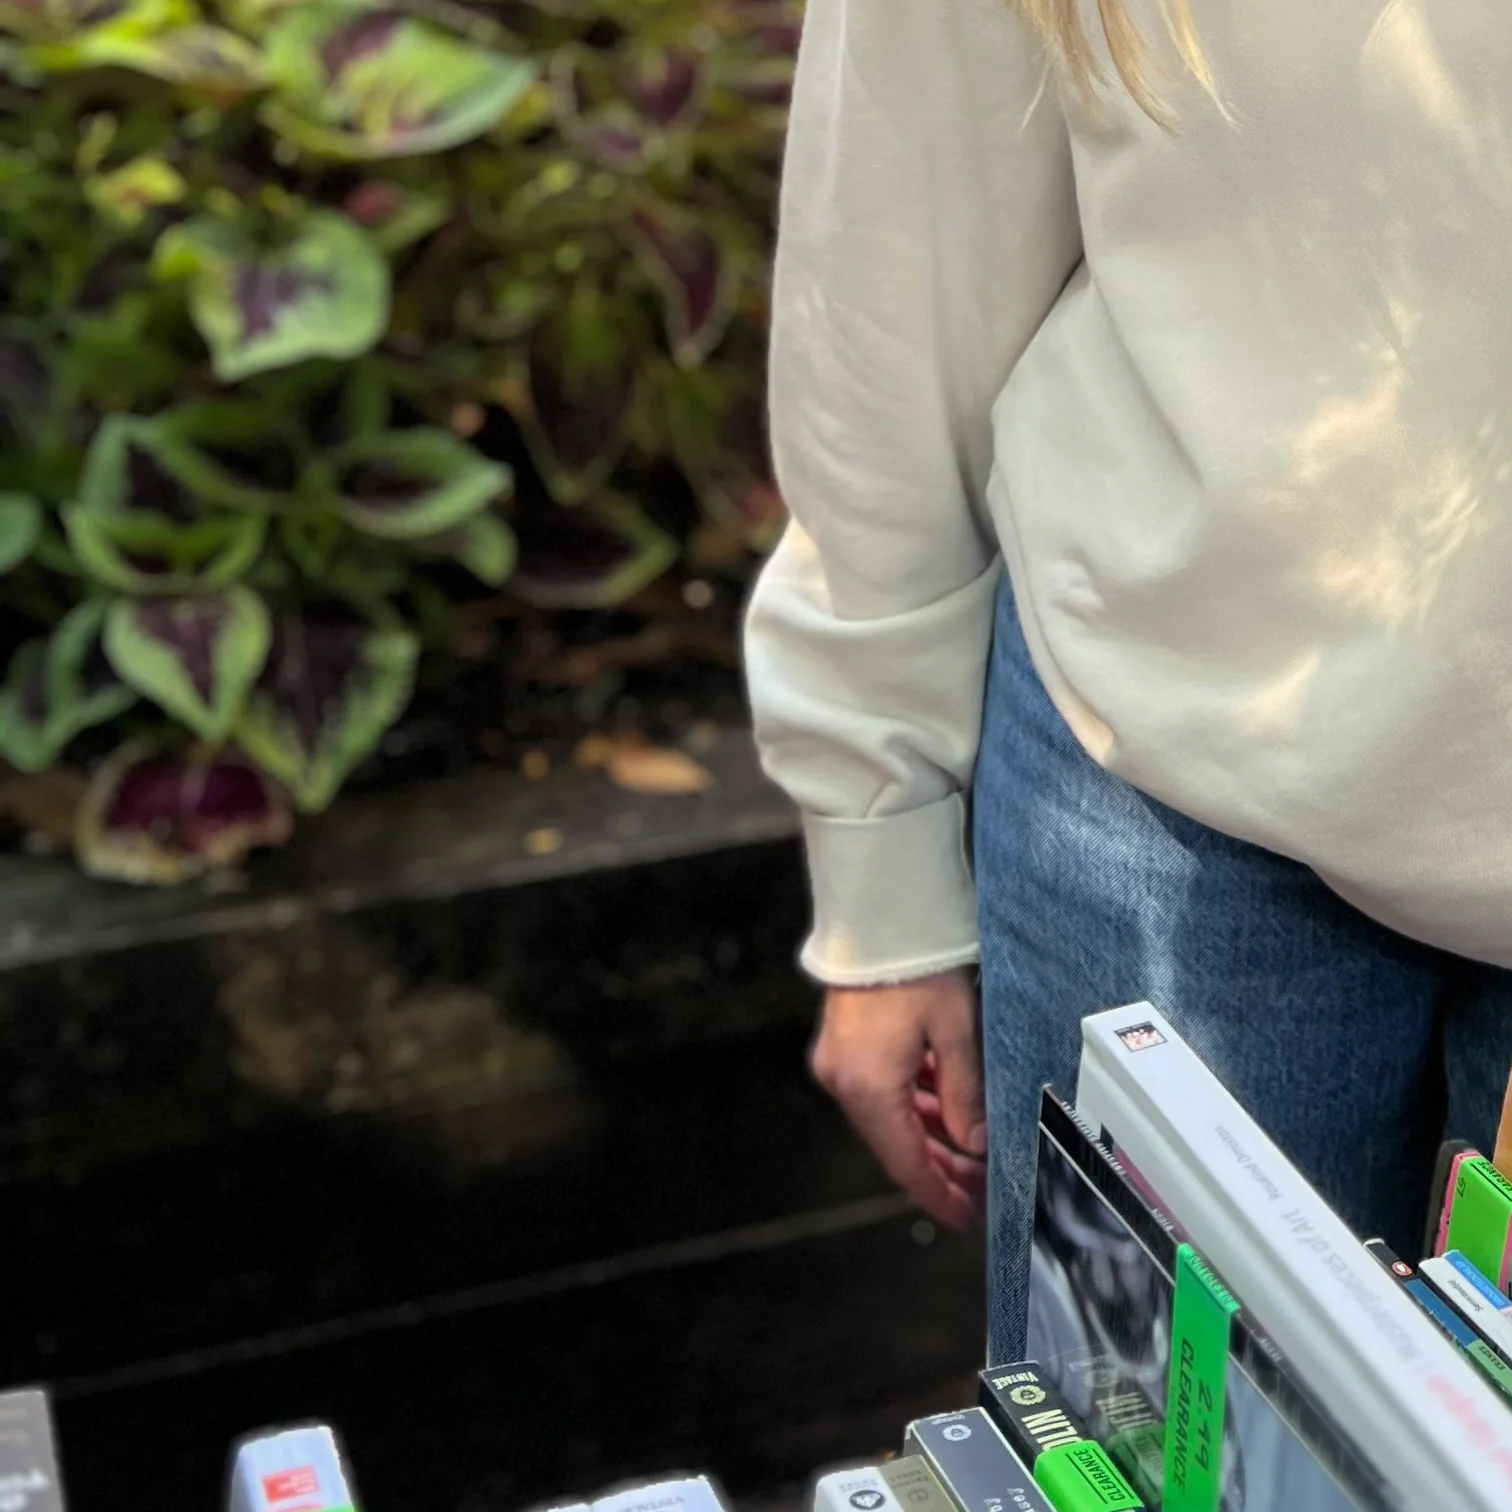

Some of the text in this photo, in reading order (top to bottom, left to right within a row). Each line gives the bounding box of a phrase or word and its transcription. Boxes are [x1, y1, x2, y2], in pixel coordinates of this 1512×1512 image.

[1281, 1207, 1315, 1242] Art
[991, 1371, 1039, 1390] VINTAGE
[1172, 1337, 1195, 1495] CLEARANCE
[1073, 1448, 1126, 1502] CLEARANCE
